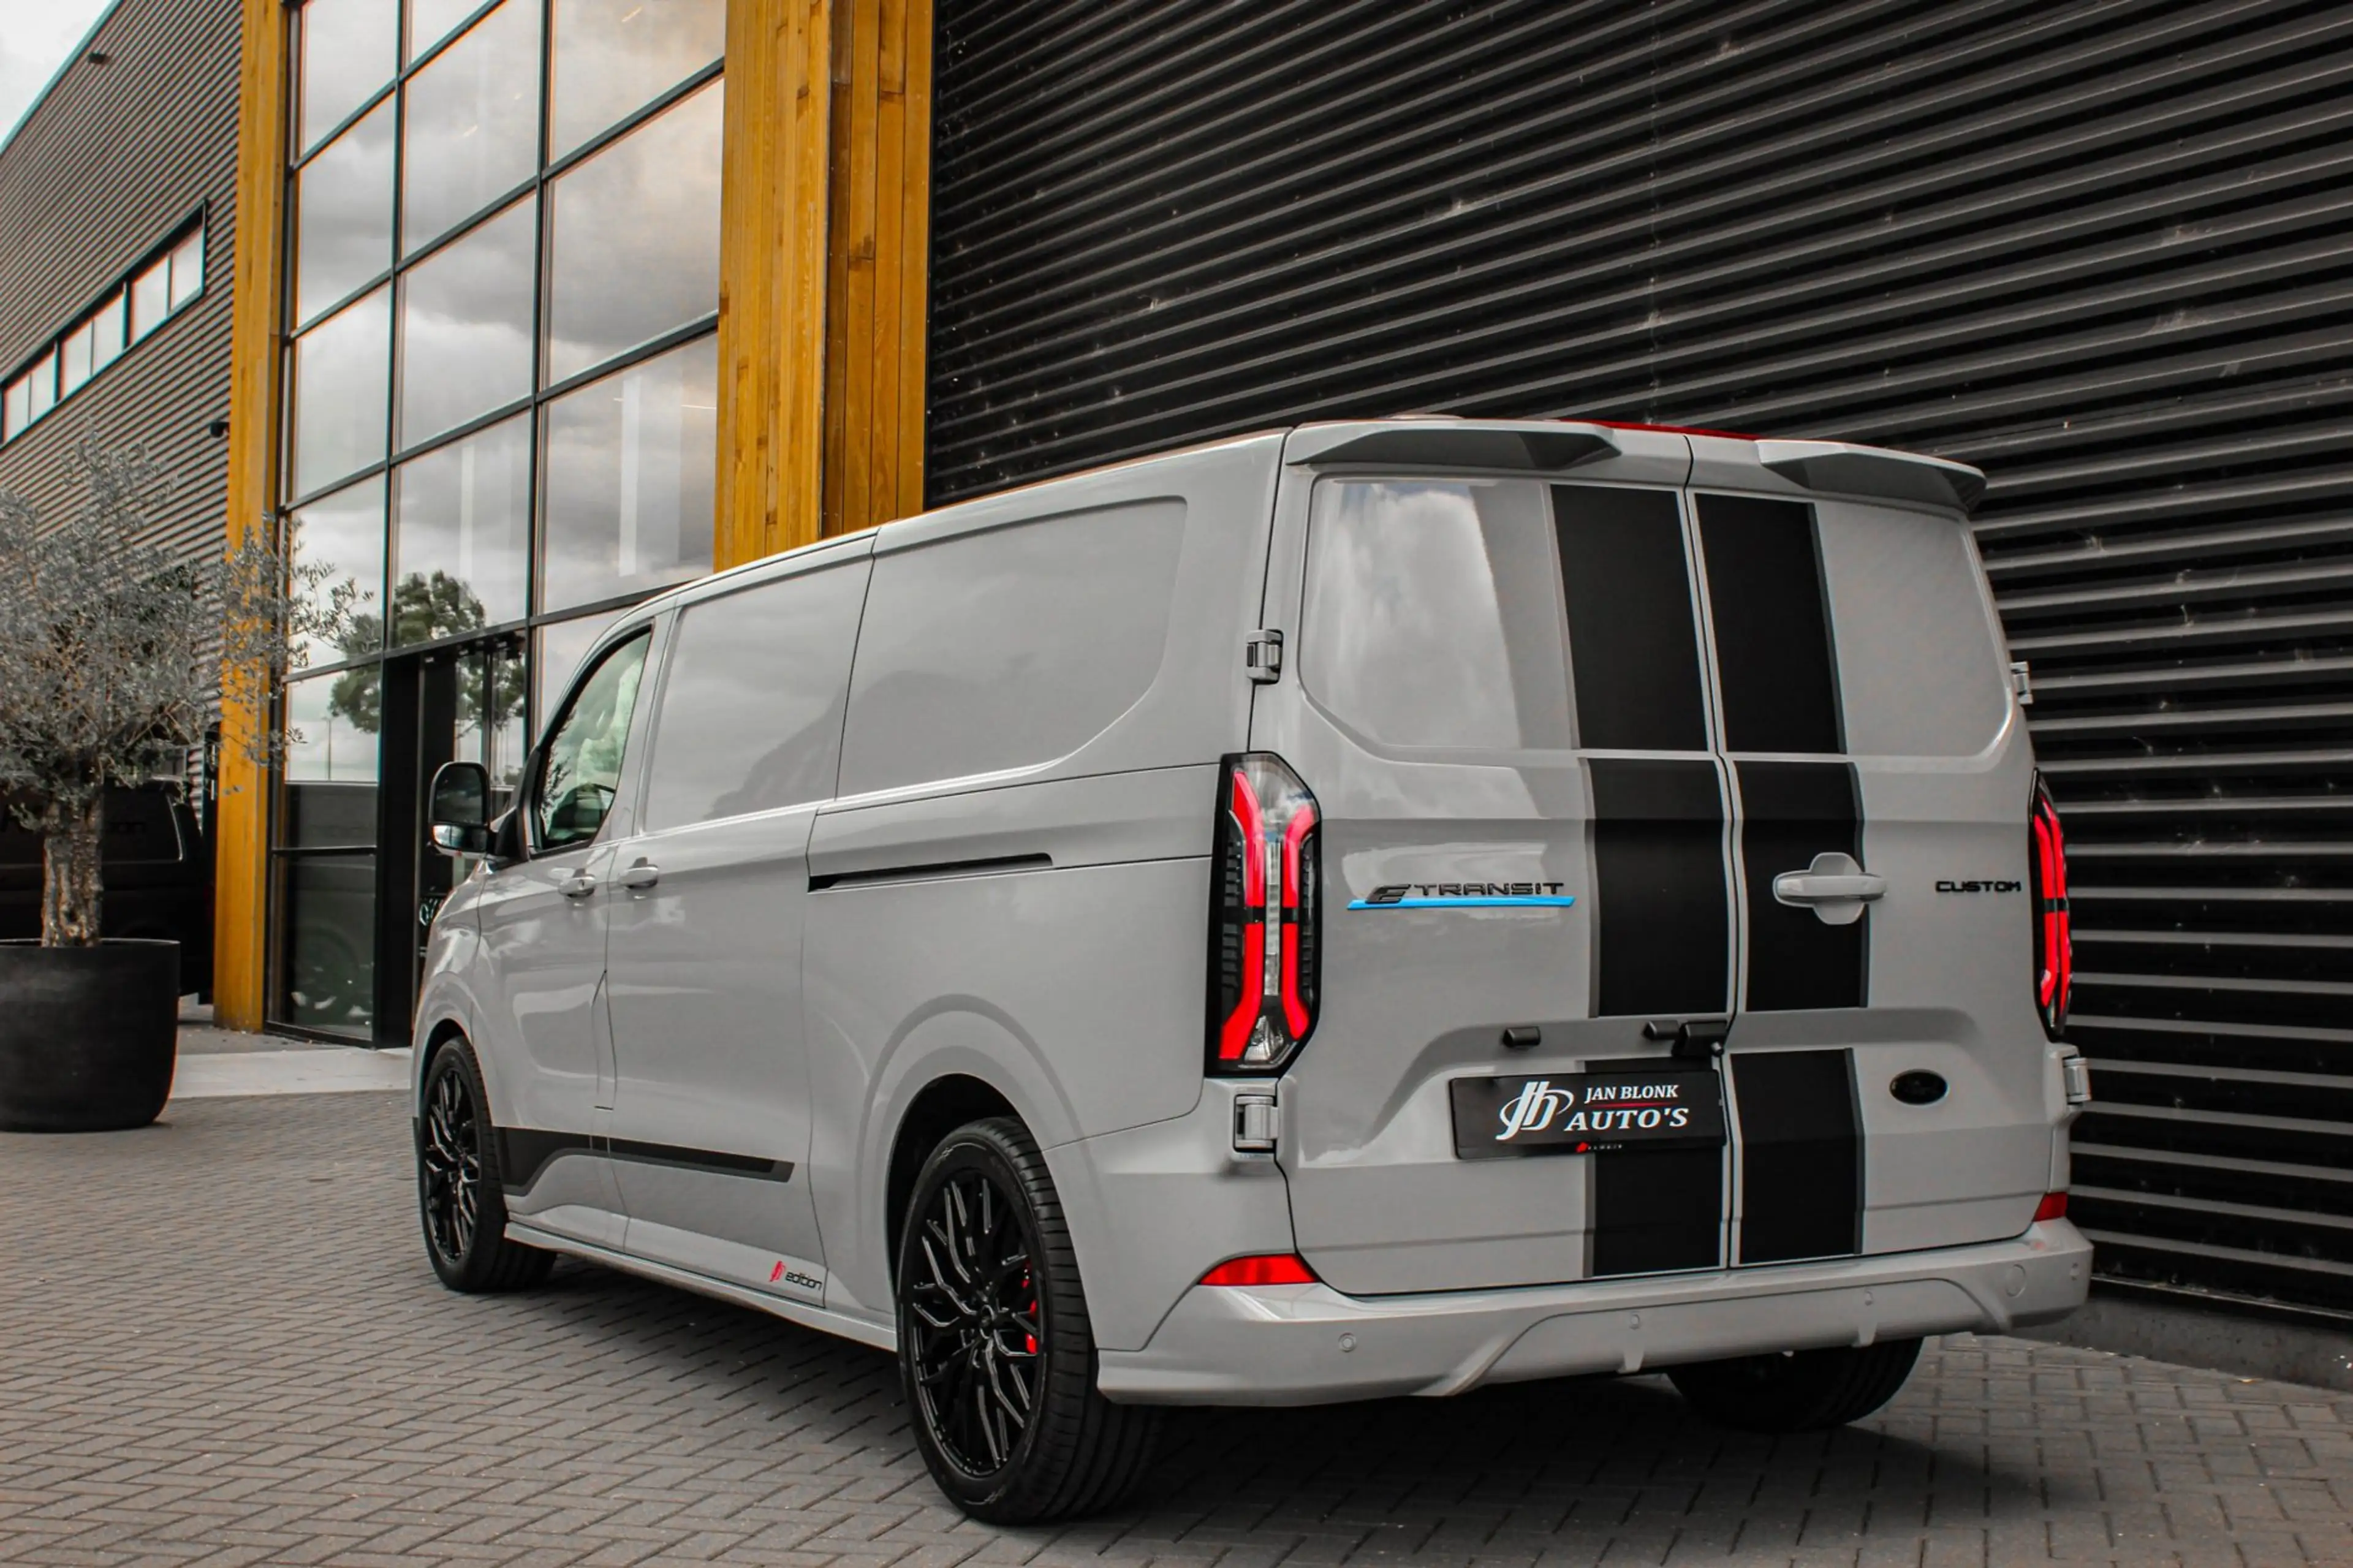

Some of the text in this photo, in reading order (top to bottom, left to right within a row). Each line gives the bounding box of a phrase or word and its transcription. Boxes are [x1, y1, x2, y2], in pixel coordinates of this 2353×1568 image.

[1935, 881, 2021, 893] CUSTOM
[1584, 1085, 1680, 1104] JAN BLONK
[1563, 1107, 1689, 1132] AUTO'S
